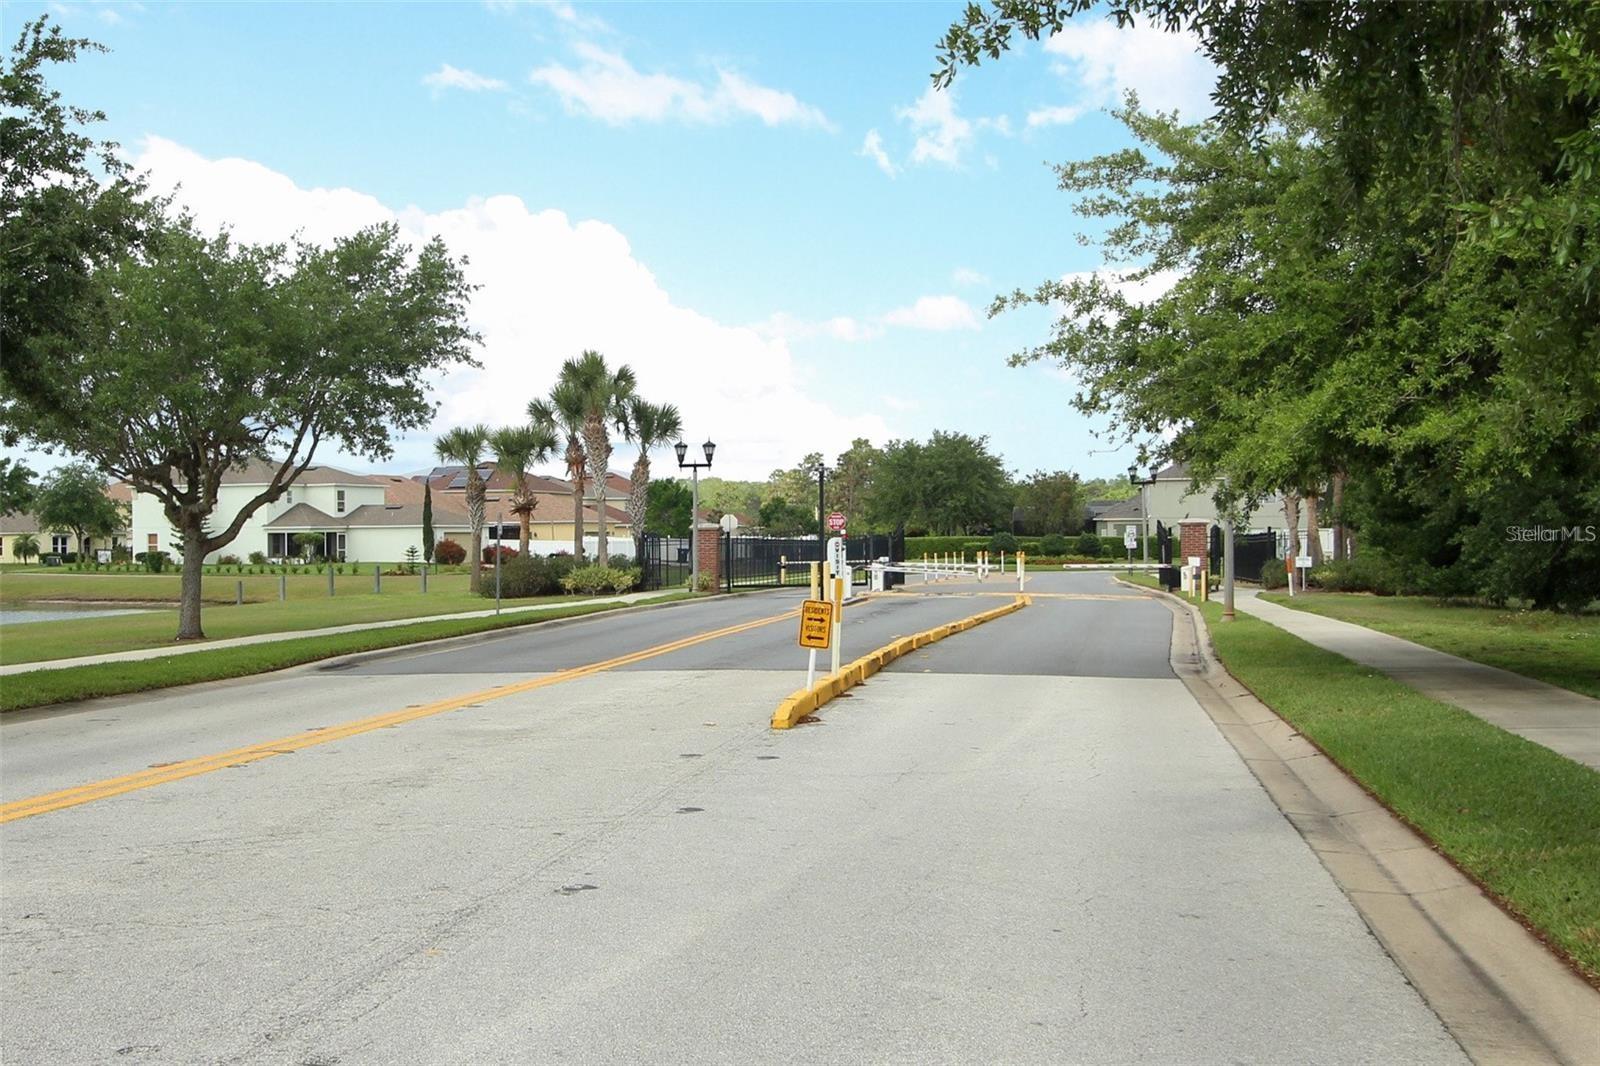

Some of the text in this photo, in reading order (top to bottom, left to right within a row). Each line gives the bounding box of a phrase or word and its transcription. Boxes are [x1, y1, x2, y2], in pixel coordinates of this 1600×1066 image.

[829, 518, 844, 526] STOP
[804, 606, 829, 615] RESIDENTS
[805, 625, 826, 633] VISITORS
